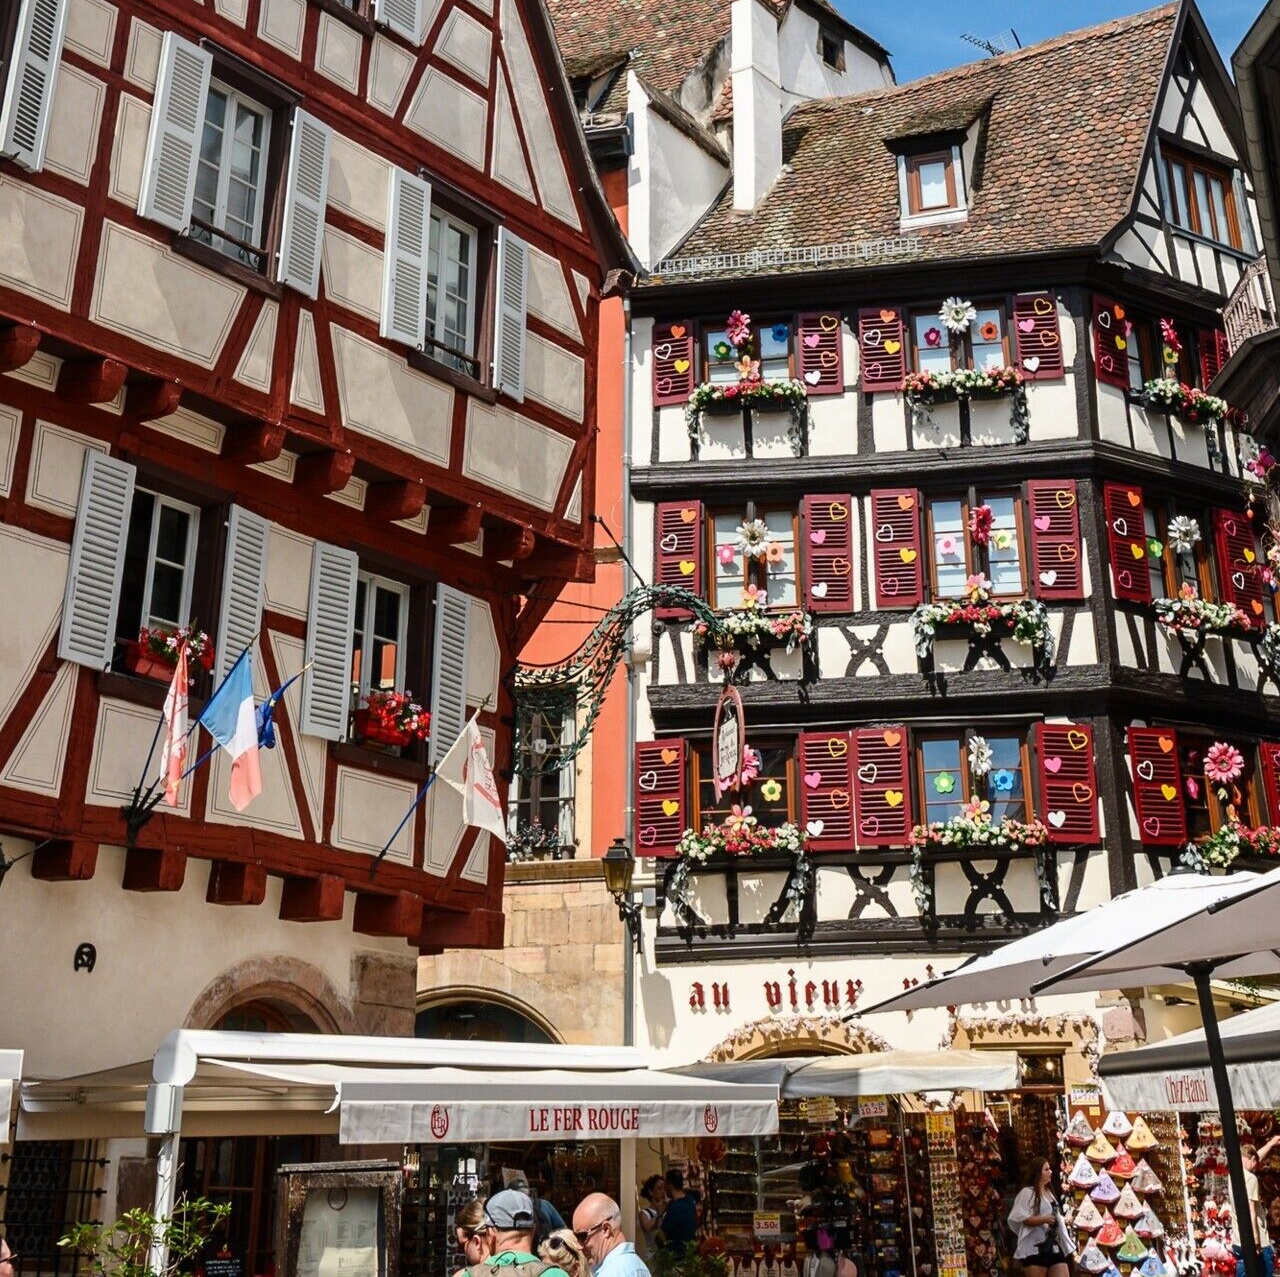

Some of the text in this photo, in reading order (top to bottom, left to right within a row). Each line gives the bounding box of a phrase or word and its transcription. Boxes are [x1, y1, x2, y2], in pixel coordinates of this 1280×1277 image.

[689, 981, 730, 1009] au
[529, 1107, 640, 1132] LE FER ROUGE
